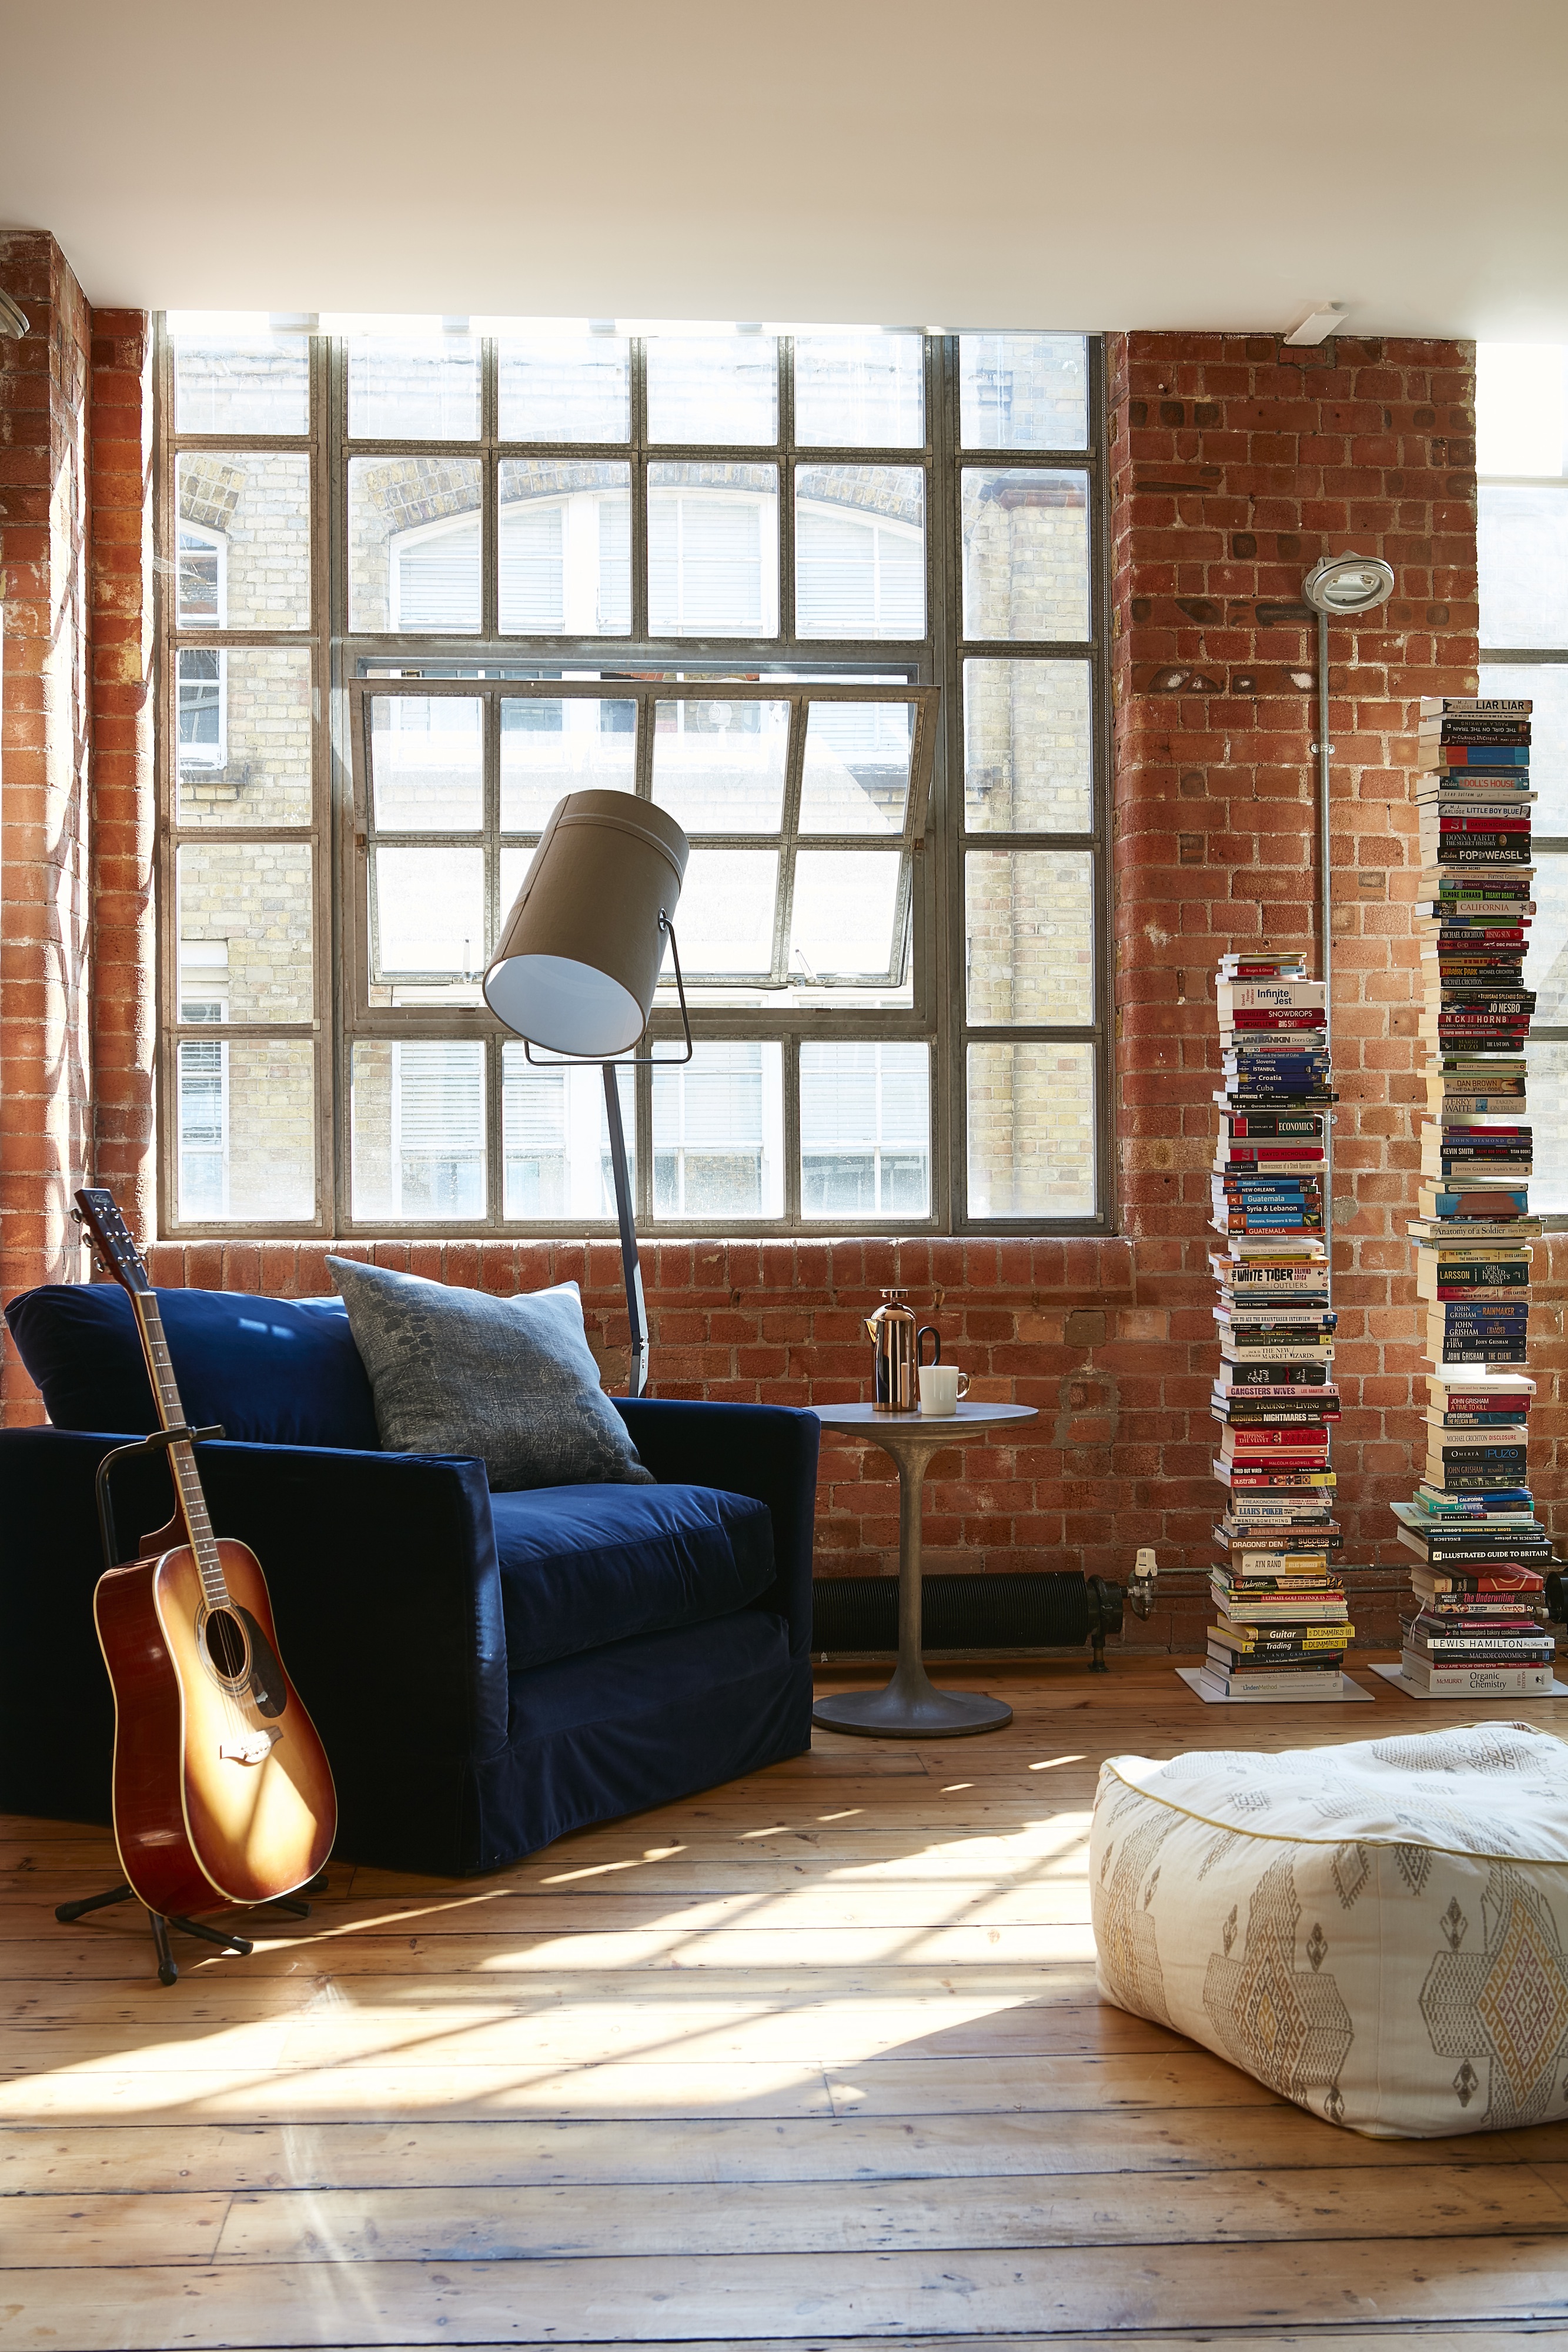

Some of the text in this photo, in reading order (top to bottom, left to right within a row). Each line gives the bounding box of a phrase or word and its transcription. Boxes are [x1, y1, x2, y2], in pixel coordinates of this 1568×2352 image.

[1476, 700, 1524, 710] LIAR LIAR
[1279, 1122, 1313, 1131] ECONOMICS
[1482, 1225, 1505, 1234] Soldier
[1440, 1271, 1470, 1279] LARSSON
[1463, 1593, 1514, 1602] The Underwriting
[1470, 1672, 1500, 1681] Organic
[1470, 1680, 1506, 1690] Chemistry
